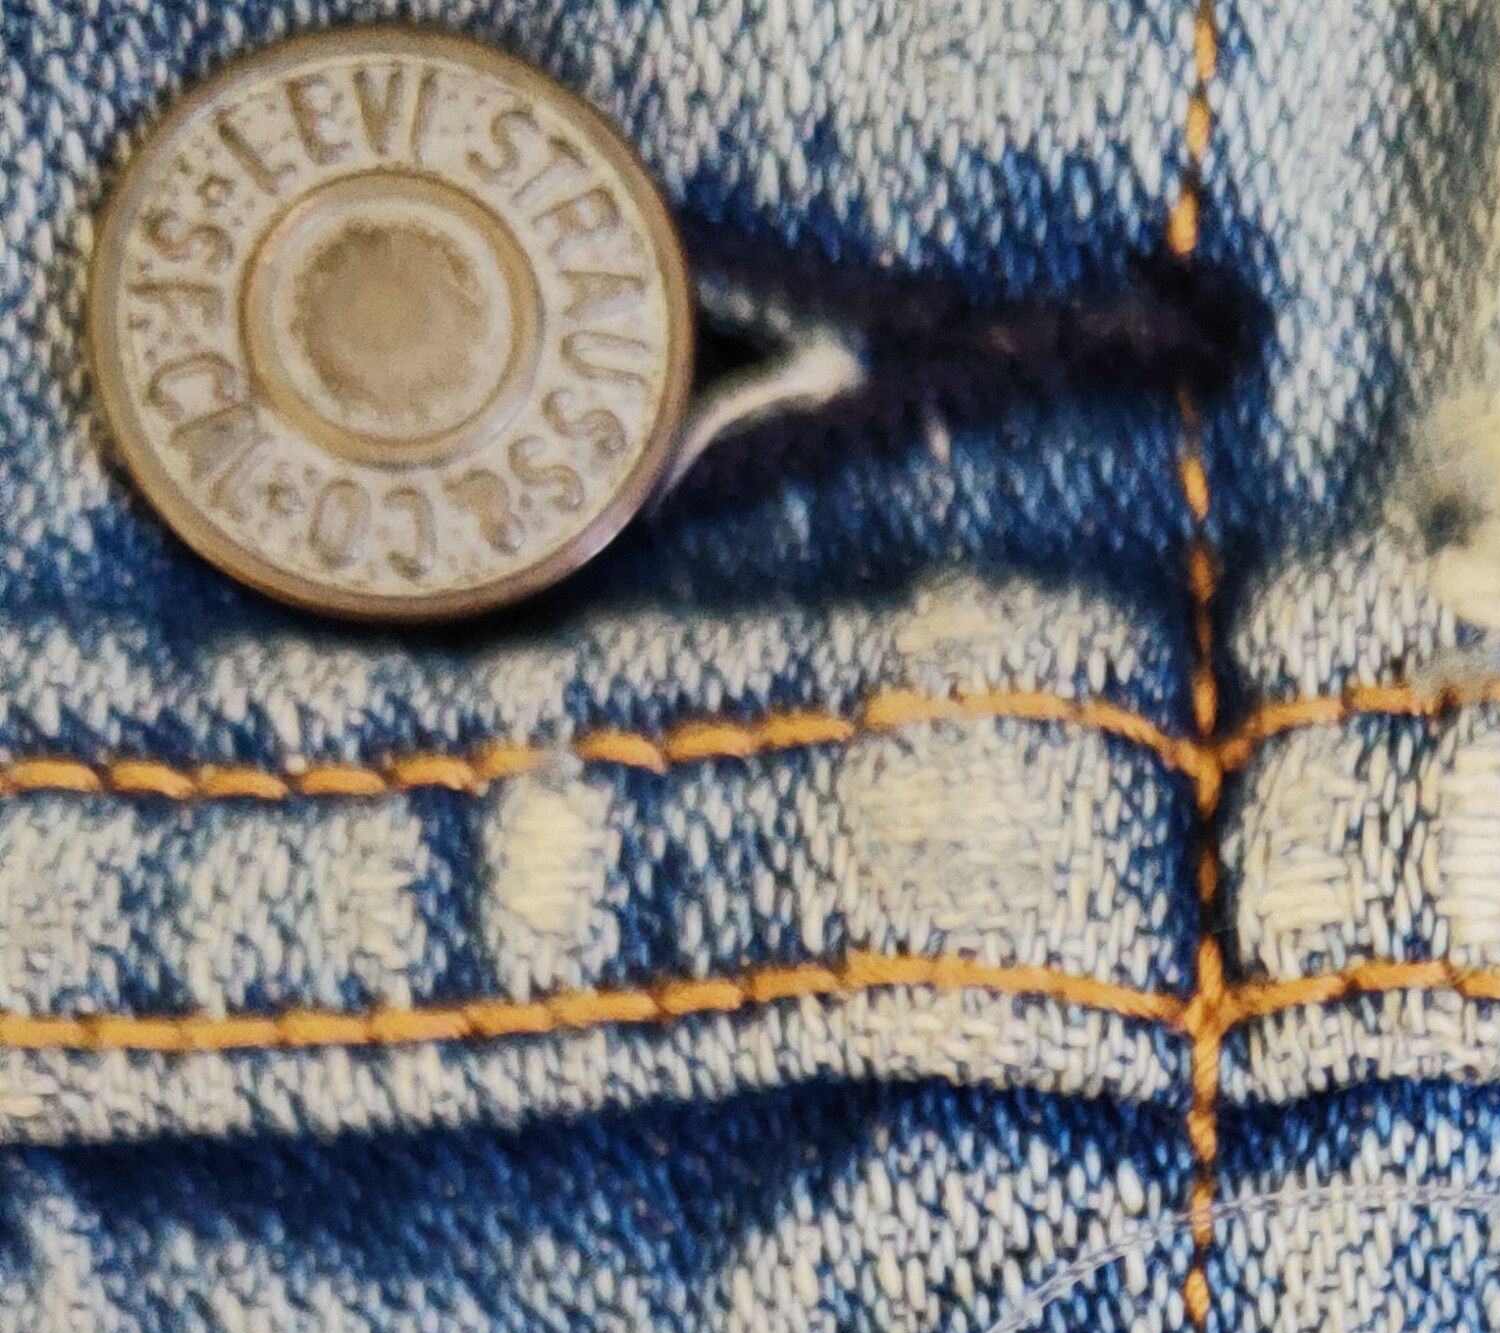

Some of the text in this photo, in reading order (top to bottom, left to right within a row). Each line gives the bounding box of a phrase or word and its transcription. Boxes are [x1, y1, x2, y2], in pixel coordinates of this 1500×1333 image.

[215, 65, 440, 197] LEVI
[465, 108, 648, 512] STRAUSS
[441, 466, 525, 555] &
